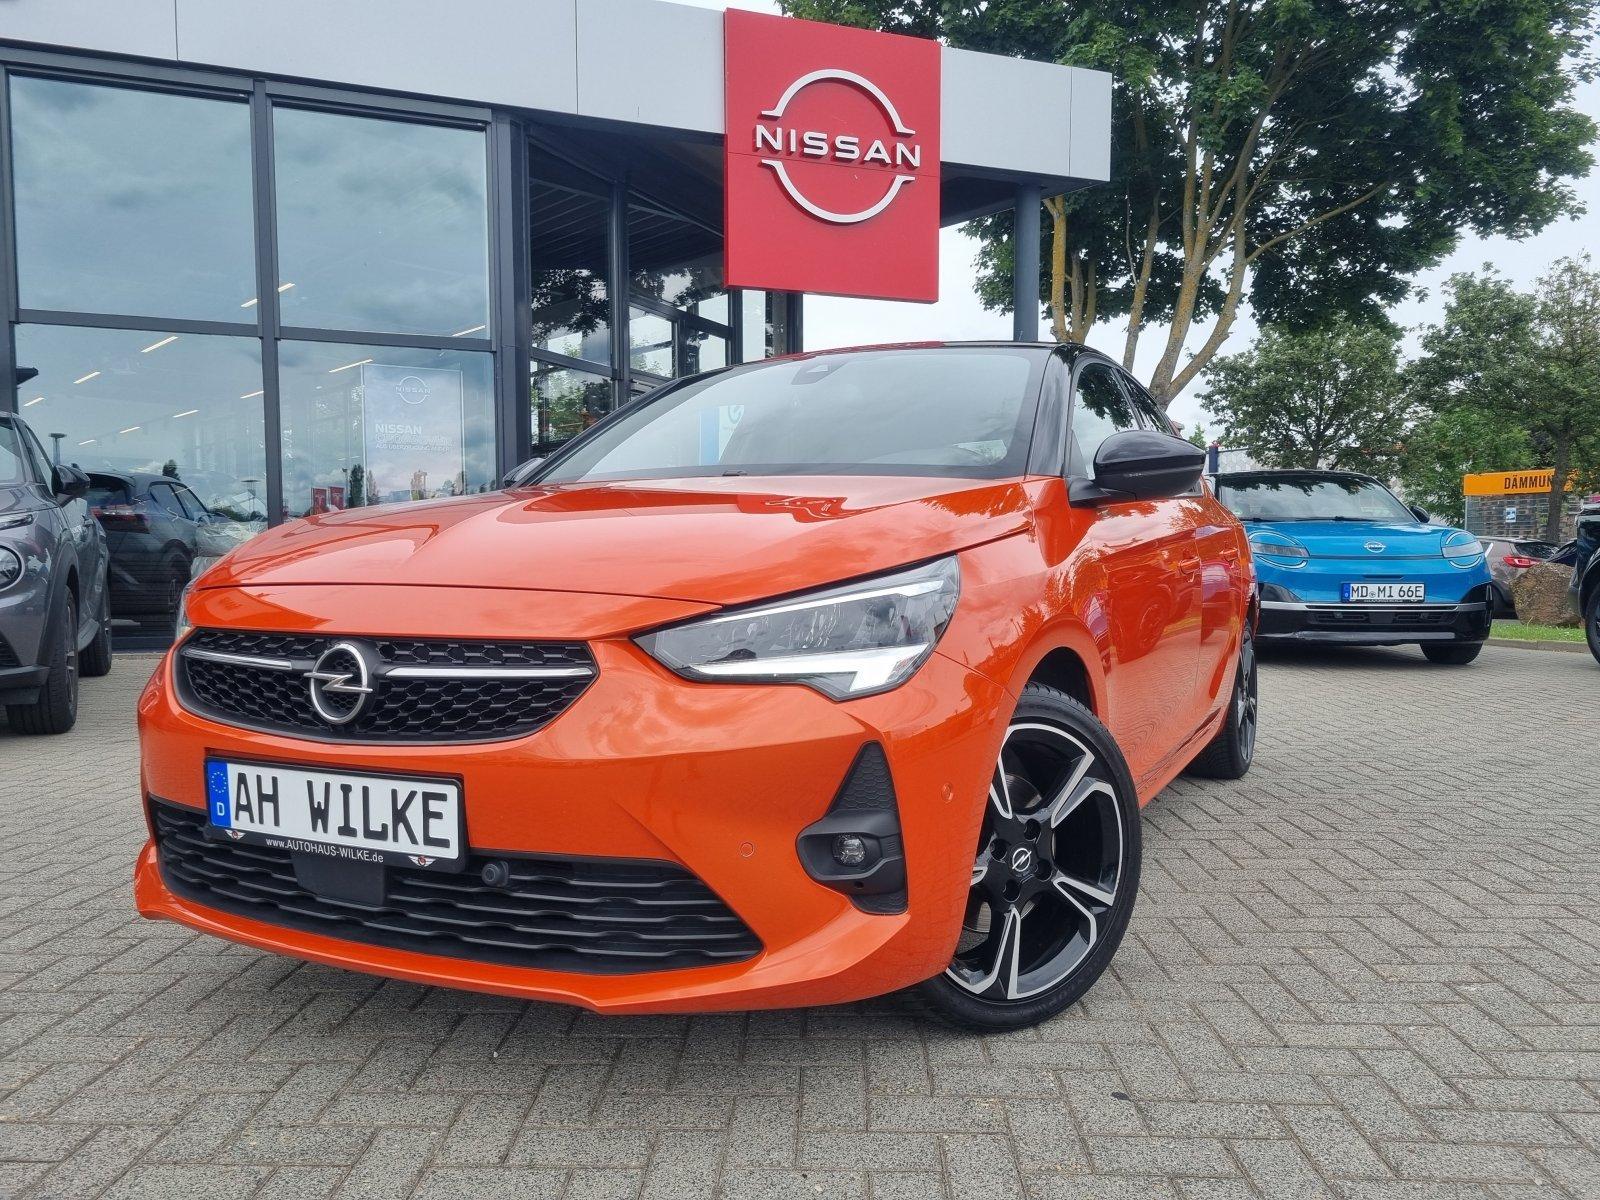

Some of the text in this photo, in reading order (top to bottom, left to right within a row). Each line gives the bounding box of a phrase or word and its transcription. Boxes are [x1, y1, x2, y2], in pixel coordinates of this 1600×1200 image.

[755, 125, 920, 167] NISSAN
[375, 423, 422, 435] NISSAN
[1351, 585, 1368, 598] MD
[1377, 585, 1393, 598] MI
[1398, 585, 1422, 598] 66E
[217, 802, 225, 816] D
[234, 772, 451, 849] AH WILKE
[266, 838, 384, 863] www.AUTOHAUS-WILKE.de
